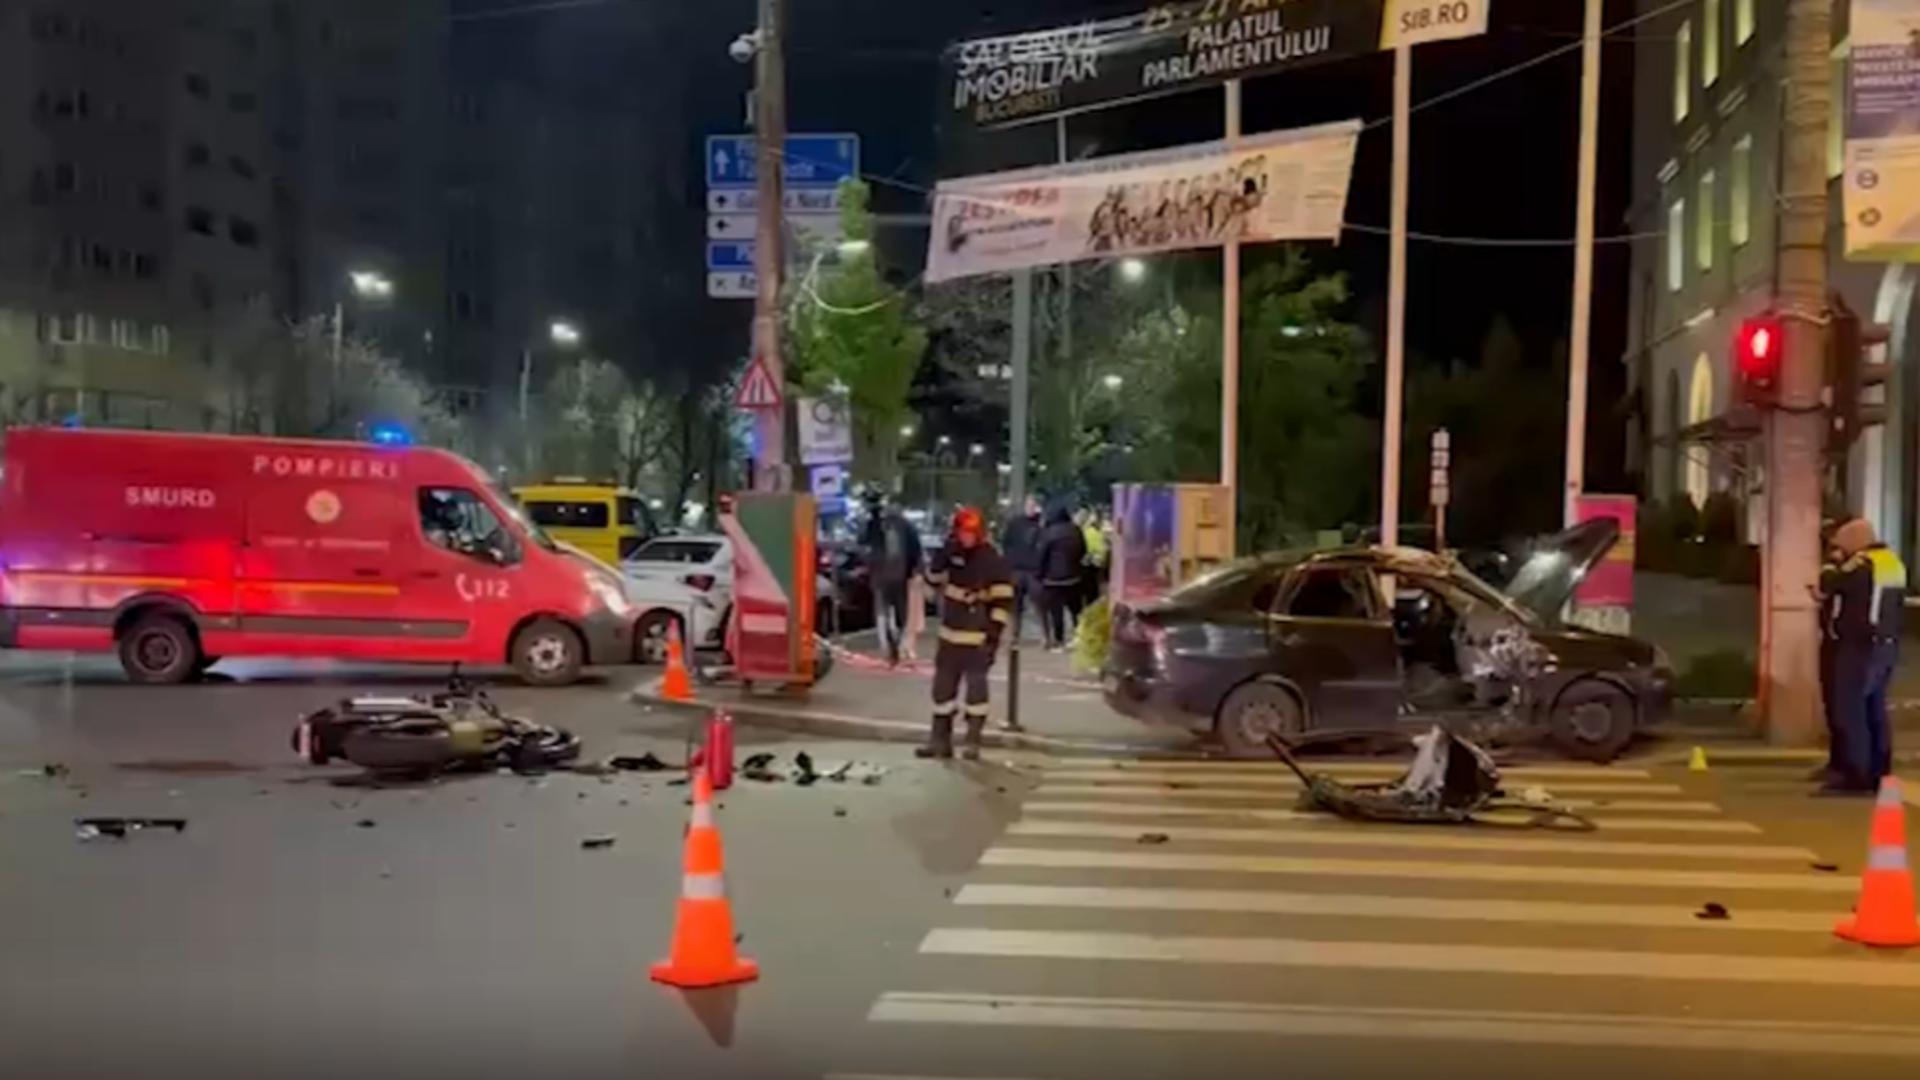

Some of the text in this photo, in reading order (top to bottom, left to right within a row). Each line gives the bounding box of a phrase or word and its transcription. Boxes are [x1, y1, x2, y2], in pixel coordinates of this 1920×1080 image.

[1188, 10, 1283, 51] PALATUL
[1400, 3, 1469, 33] SIB.RO
[1143, 27, 1331, 86] PARLAMENTULUI
[955, 51, 1098, 108] IMOBILIAR
[253, 456, 398, 478] POMPIERI
[125, 486, 216, 507] SMURD
[474, 579, 510, 598] 112
